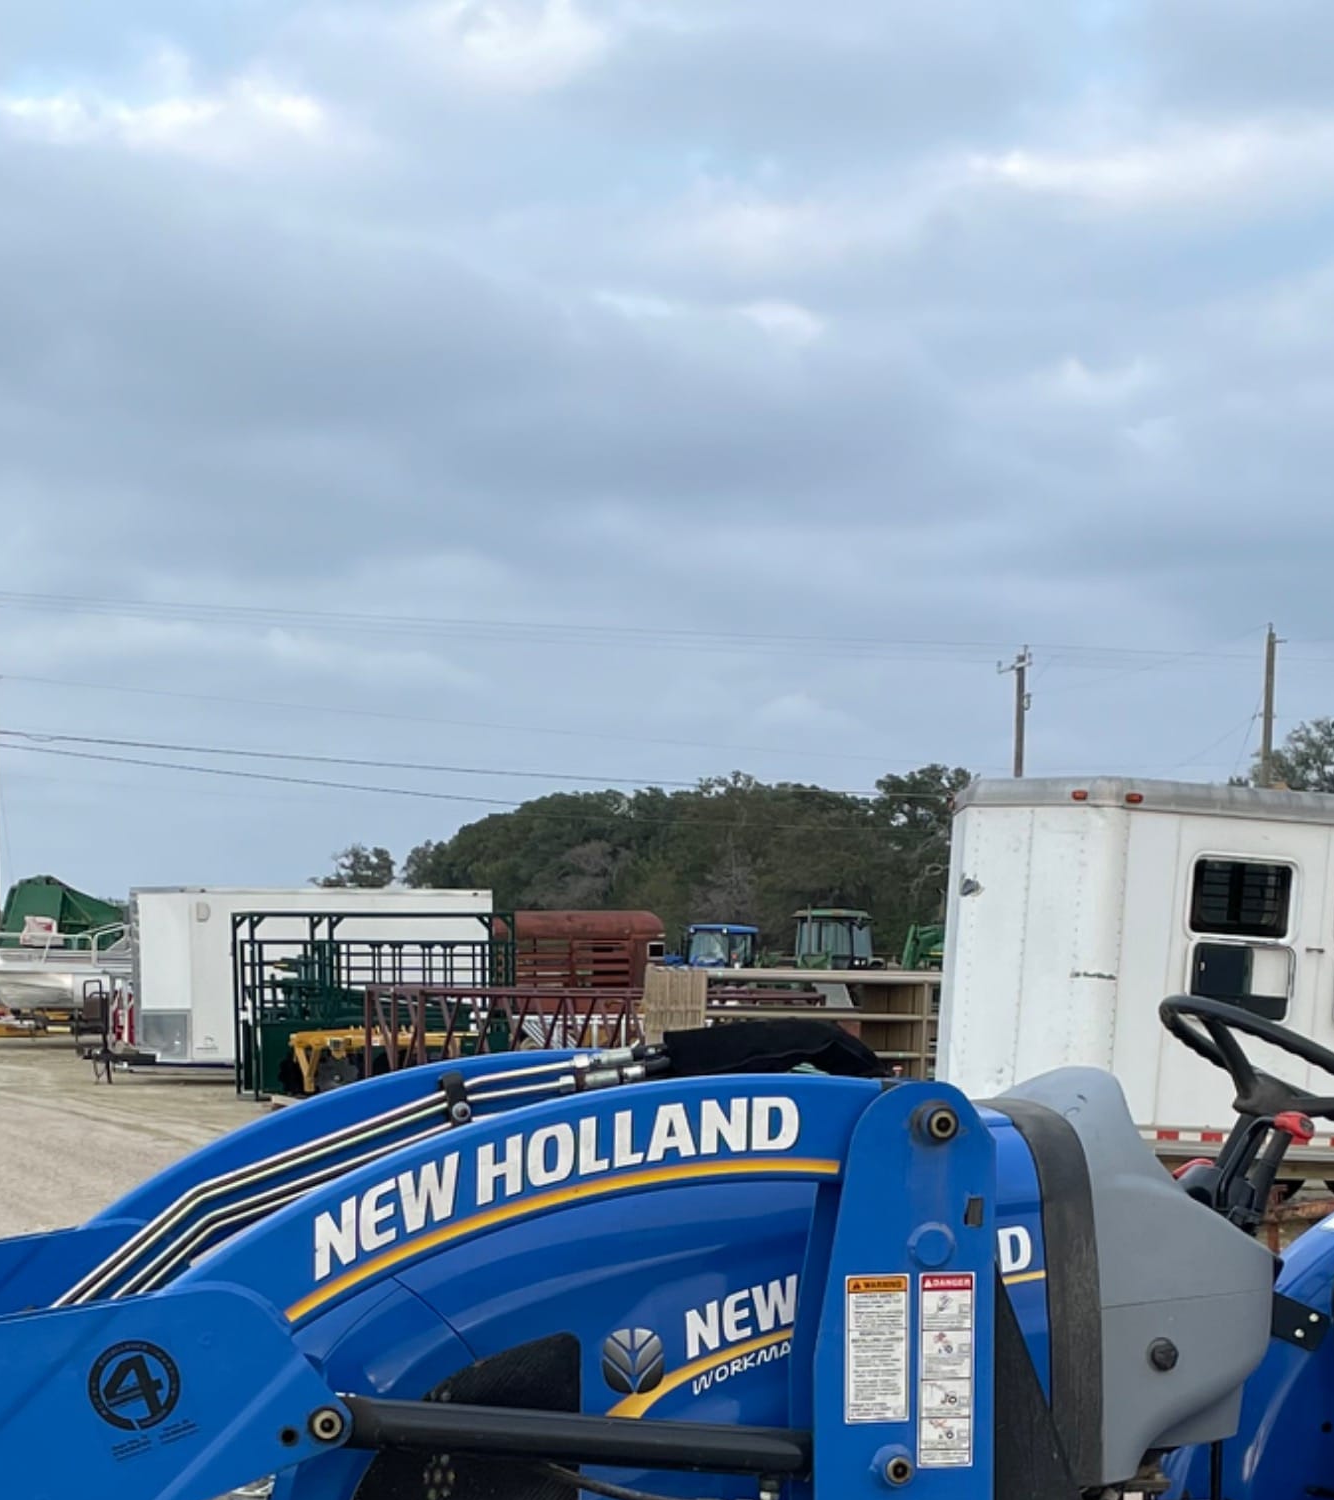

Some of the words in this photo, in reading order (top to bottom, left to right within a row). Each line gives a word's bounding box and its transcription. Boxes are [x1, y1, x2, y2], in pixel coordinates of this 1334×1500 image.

[314, 1151, 460, 1281] NEW
[476, 1096, 800, 1206] HOLLAND
[685, 1273, 798, 1360] NEW
[932, 1278, 971, 1287] DANGER
